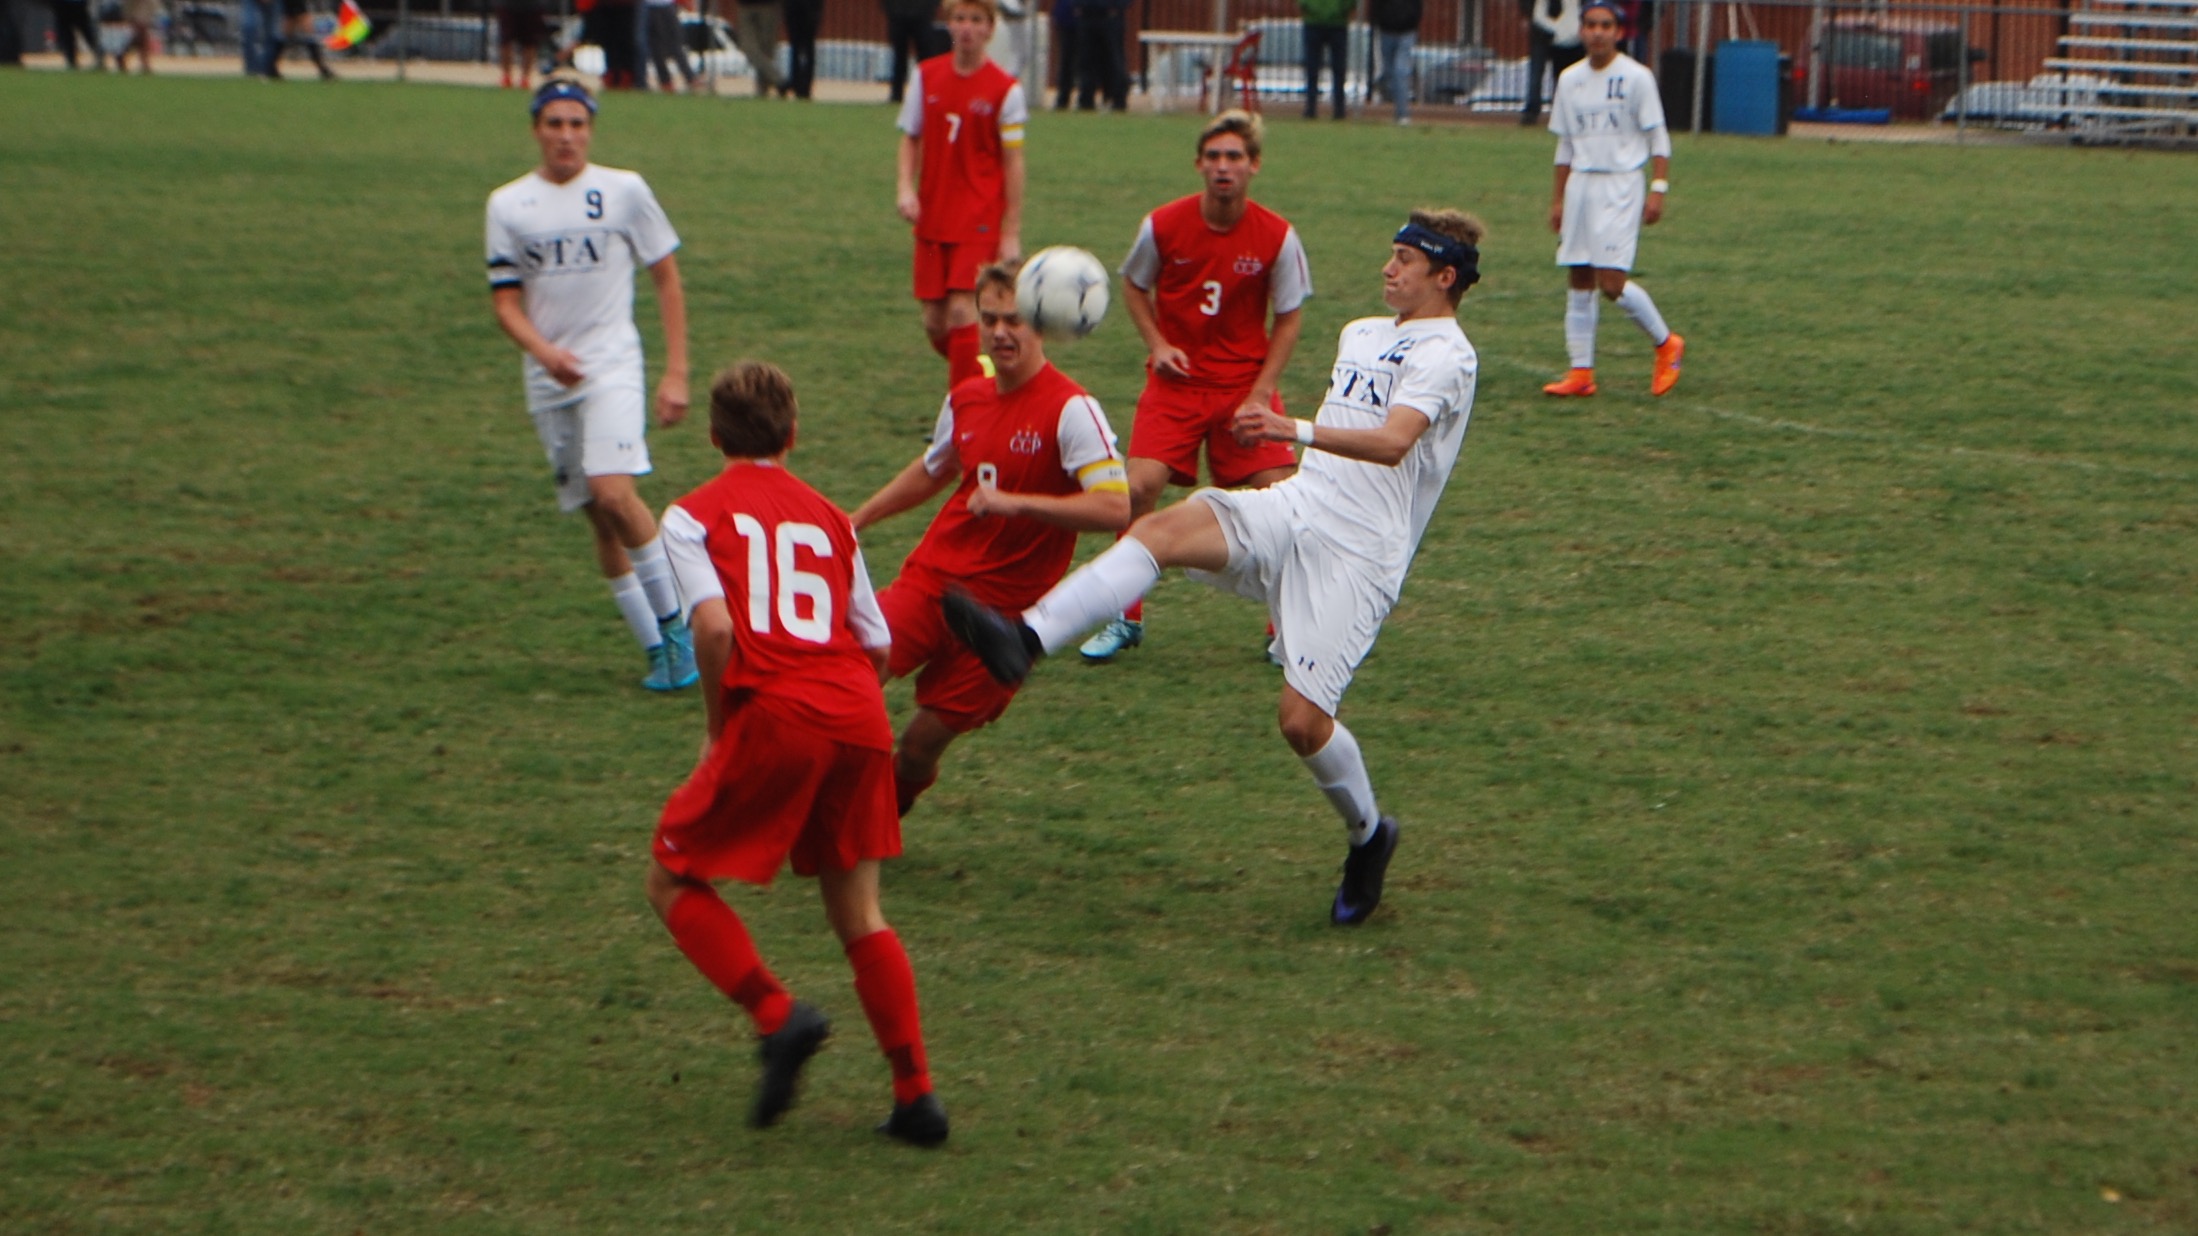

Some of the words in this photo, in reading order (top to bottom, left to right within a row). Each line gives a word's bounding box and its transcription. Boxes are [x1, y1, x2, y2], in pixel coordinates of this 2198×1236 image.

[945, 112, 961, 144] 7
[586, 189, 603, 219] 9
[525, 237, 599, 267] STA
[1200, 279, 1222, 316] 3
[1330, 366, 1382, 407] TA
[1009, 434, 1042, 455] CCP
[733, 513, 833, 644] 16
